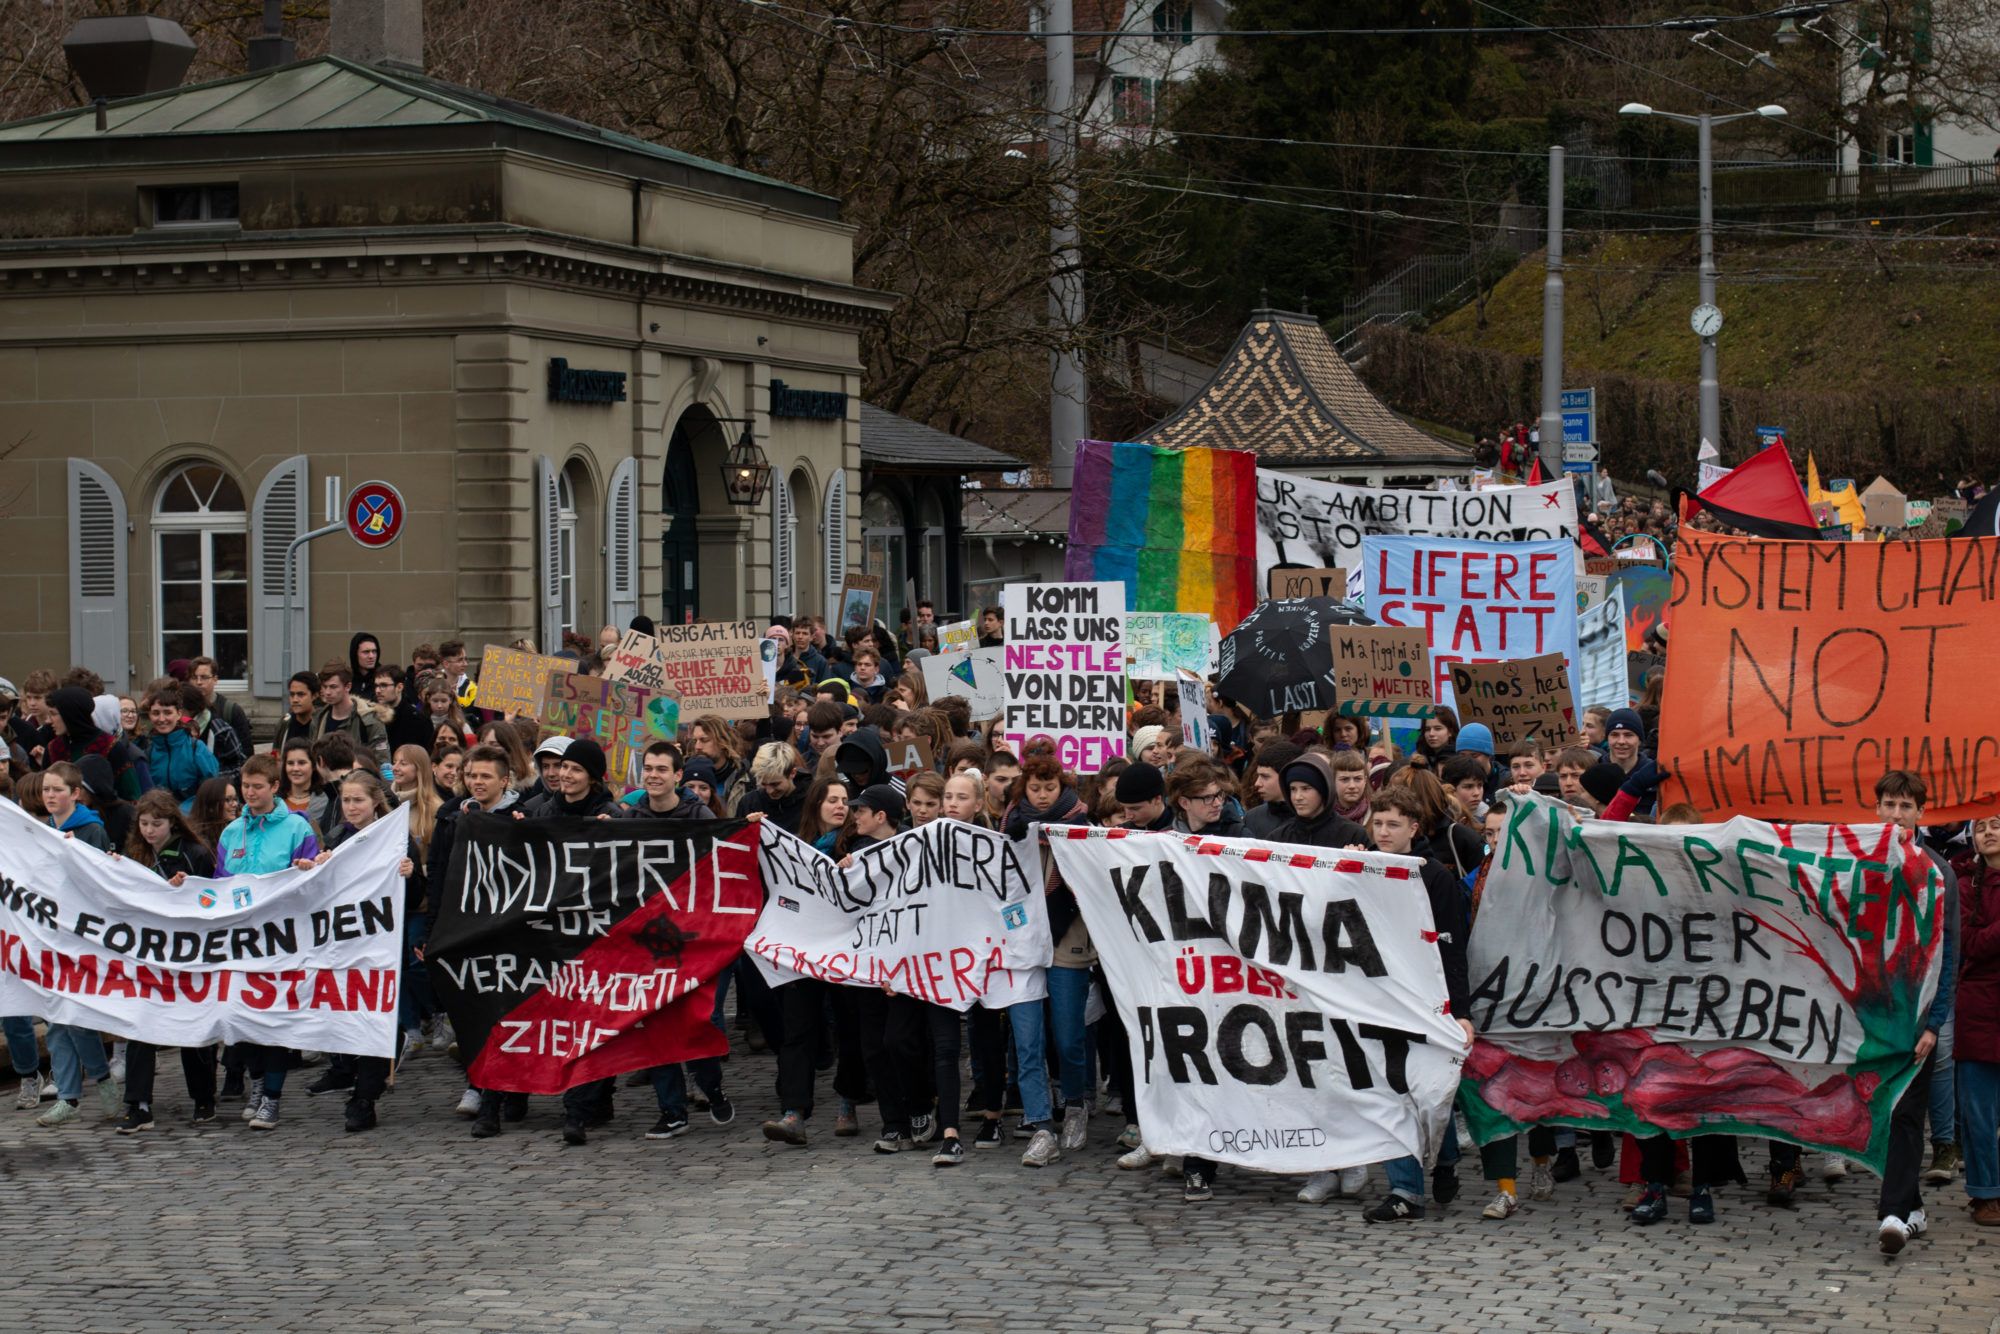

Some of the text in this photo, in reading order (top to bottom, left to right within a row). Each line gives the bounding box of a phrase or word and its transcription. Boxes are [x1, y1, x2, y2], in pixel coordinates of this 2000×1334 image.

[1322, 491, 1512, 527] AMBITION
[1277, 511, 1383, 549] STO
[1379, 549, 1558, 601] LIFERE
[1586, 561, 1614, 574] STOP
[1026, 586, 1098, 614] KOMM
[623, 631, 647, 650] IF
[660, 621, 756, 643] MStG Art. 119
[1010, 617, 1120, 642] LASS UNS
[1380, 601, 1555, 654] STATT
[1005, 643, 1122, 672] NESTLÉ
[1255, 630, 1286, 661] POLITIK
[641, 663, 663, 679] ACT
[665, 656, 754, 680] BEIHILFE ZUM
[1454, 668, 1523, 698] Dinos
[1533, 665, 1568, 694] hei
[1727, 622, 1970, 738] NOT
[551, 673, 651, 718] ES IST
[674, 676, 751, 697] SELBSTMORD
[1004, 673, 1125, 704] VON DEN
[1269, 681, 1318, 715] LASST
[1372, 677, 1432, 699] MUETER
[683, 698, 713, 710] GANZE
[1006, 704, 1124, 732] FELDERN
[1492, 696, 1558, 727] gmeint
[547, 702, 645, 748] UNSERE
[460, 836, 756, 914] INDUSTRIE
[1684, 837, 1939, 946] RETTEN
[74, 918, 298, 963] FORDERN
[310, 896, 394, 947] DEN
[852, 903, 928, 950] STATT
[1109, 860, 1389, 978] KLIMA
[1601, 909, 1772, 964] ODER
[1175, 946, 1299, 1000] ÜBER
[1468, 955, 1843, 1065] AUSSTERBEN
[1137, 1003, 1427, 1096] PROFIT
[1208, 1126, 1327, 1154] ORGANIZED
